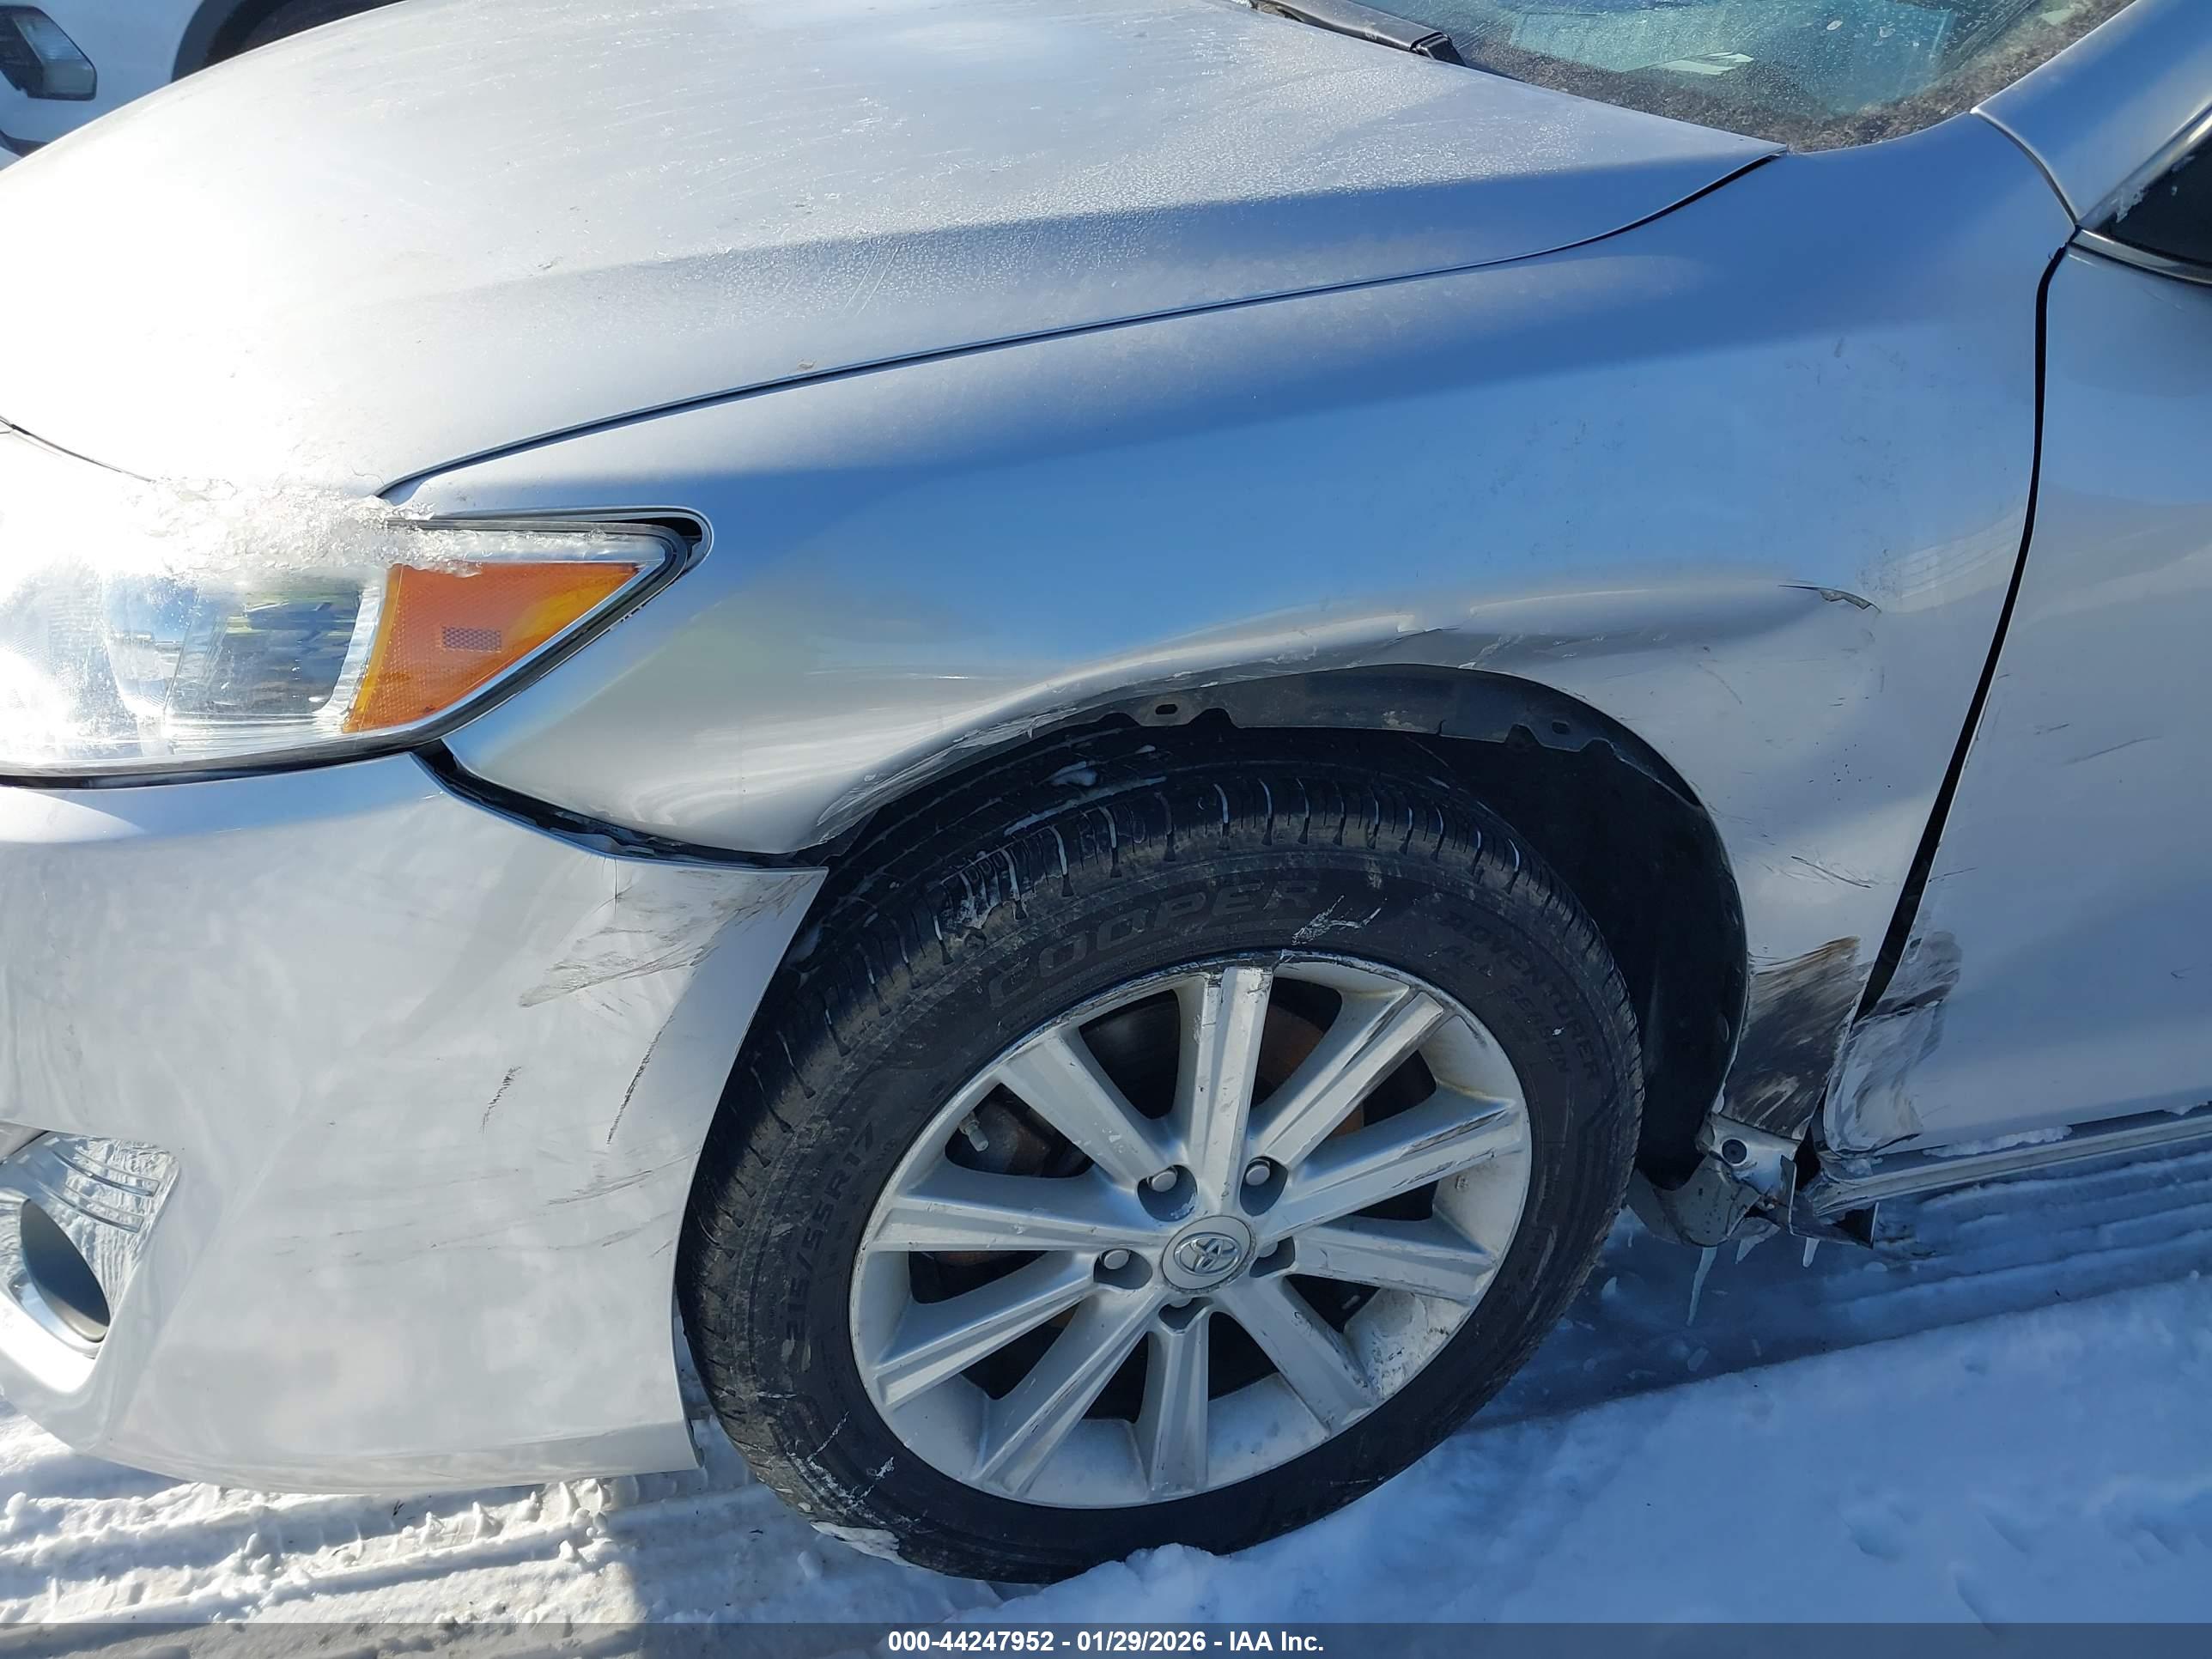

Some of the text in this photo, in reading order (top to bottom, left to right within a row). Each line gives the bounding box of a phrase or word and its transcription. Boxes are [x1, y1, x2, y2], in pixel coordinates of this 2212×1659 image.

[987, 879, 1321, 1008] COOPER
[1437, 912, 1601, 1079] ADVENTURER
[785, 1120, 874, 1338] 215/55R17
